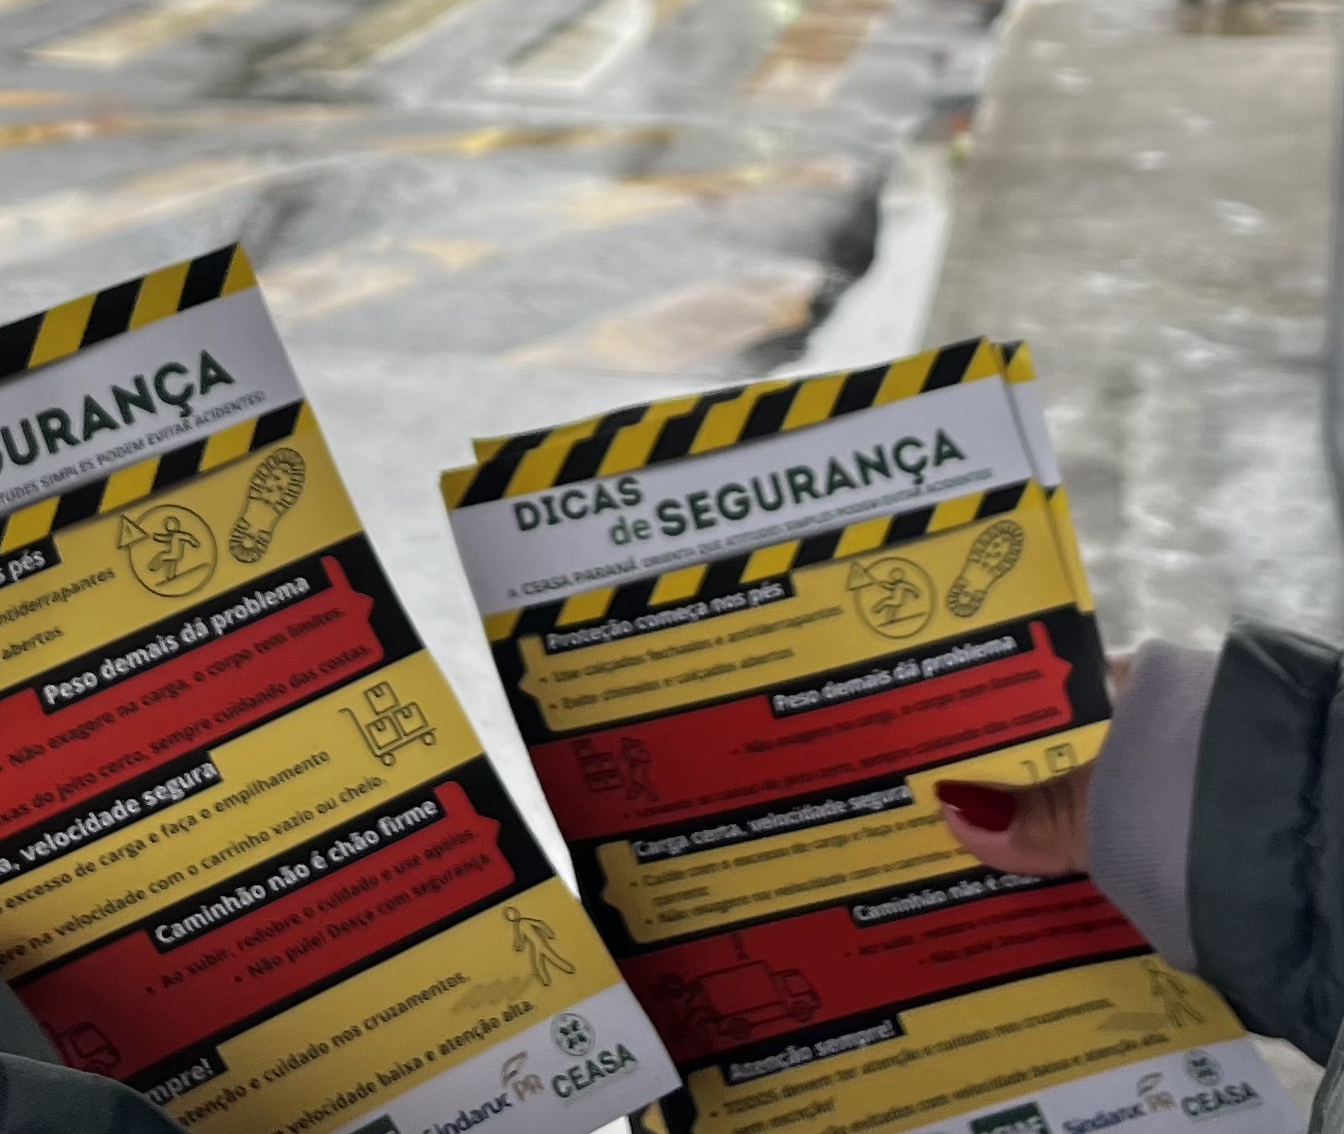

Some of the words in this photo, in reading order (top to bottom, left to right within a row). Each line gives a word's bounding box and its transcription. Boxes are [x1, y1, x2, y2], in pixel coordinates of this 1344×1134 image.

[512, 475, 643, 532] DICAS
[607, 513, 652, 547] de
[654, 430, 965, 537] SEGURANÇA
[5, 548, 47, 581] pés
[709, 591, 747, 612] nos
[42, 669, 99, 705] Peso
[98, 632, 180, 681] demais
[177, 616, 210, 644] dá
[208, 574, 311, 636] problema
[6, 741, 46, 767] Não
[46, 710, 116, 751] exagere
[115, 699, 139, 718] na
[191, 669, 207, 683] o
[205, 647, 255, 678] corpo
[253, 631, 288, 655] tem
[30, 789, 56, 809] do
[54, 770, 99, 803] jeito
[148, 716, 213, 755] sempre
[211, 680, 289, 725] cuidando
[287, 667, 318, 689] das
[3, 871, 73, 910] excesso
[72, 859, 97, 878] de
[97, 837, 147, 868] carga
[147, 832, 160, 844] e
[159, 812, 199, 839] faça
[198, 806, 212, 820] o
[212, 749, 331, 815] empilhamento
[18, 795, 141, 862] velocidade
[141, 761, 219, 808] segura
[27, 931, 53, 951] na
[53, 886, 146, 939] velocidade
[147, 870, 185, 895] com
[186, 863, 199, 877] o
[199, 828, 271, 871] carrinho
[269, 807, 315, 836] vazio
[313, 796, 339, 815] ou
[337, 774, 384, 804] cheio.
[153, 881, 266, 945] Caminhão
[266, 860, 311, 892] não
[308, 849, 328, 871] é
[326, 826, 380, 863] chão
[377, 798, 438, 838] firme
[158, 968, 185, 990] Ao
[234, 911, 303, 953] redobre
[300, 904, 317, 919] o
[314, 872, 380, 913] cuidado
[379, 867, 393, 882] e
[391, 852, 422, 875] use
[245, 952, 284, 979] Não
[375, 890, 412, 916] com
[143, 1056, 218, 1111] mpre!
[247, 1075, 262, 1091] e
[260, 1039, 330, 1085] cuidado
[329, 1023, 363, 1049] nos
[361, 969, 469, 1033] cruzamentos.
[283, 1078, 377, 1134] velocidade
[374, 1054, 425, 1088] baixa
[423, 1048, 436, 1062] e
[436, 1014, 501, 1057] atenção
[549, 1040, 637, 1101] CEASA
[1180, 1080, 1259, 1118] CEASA
